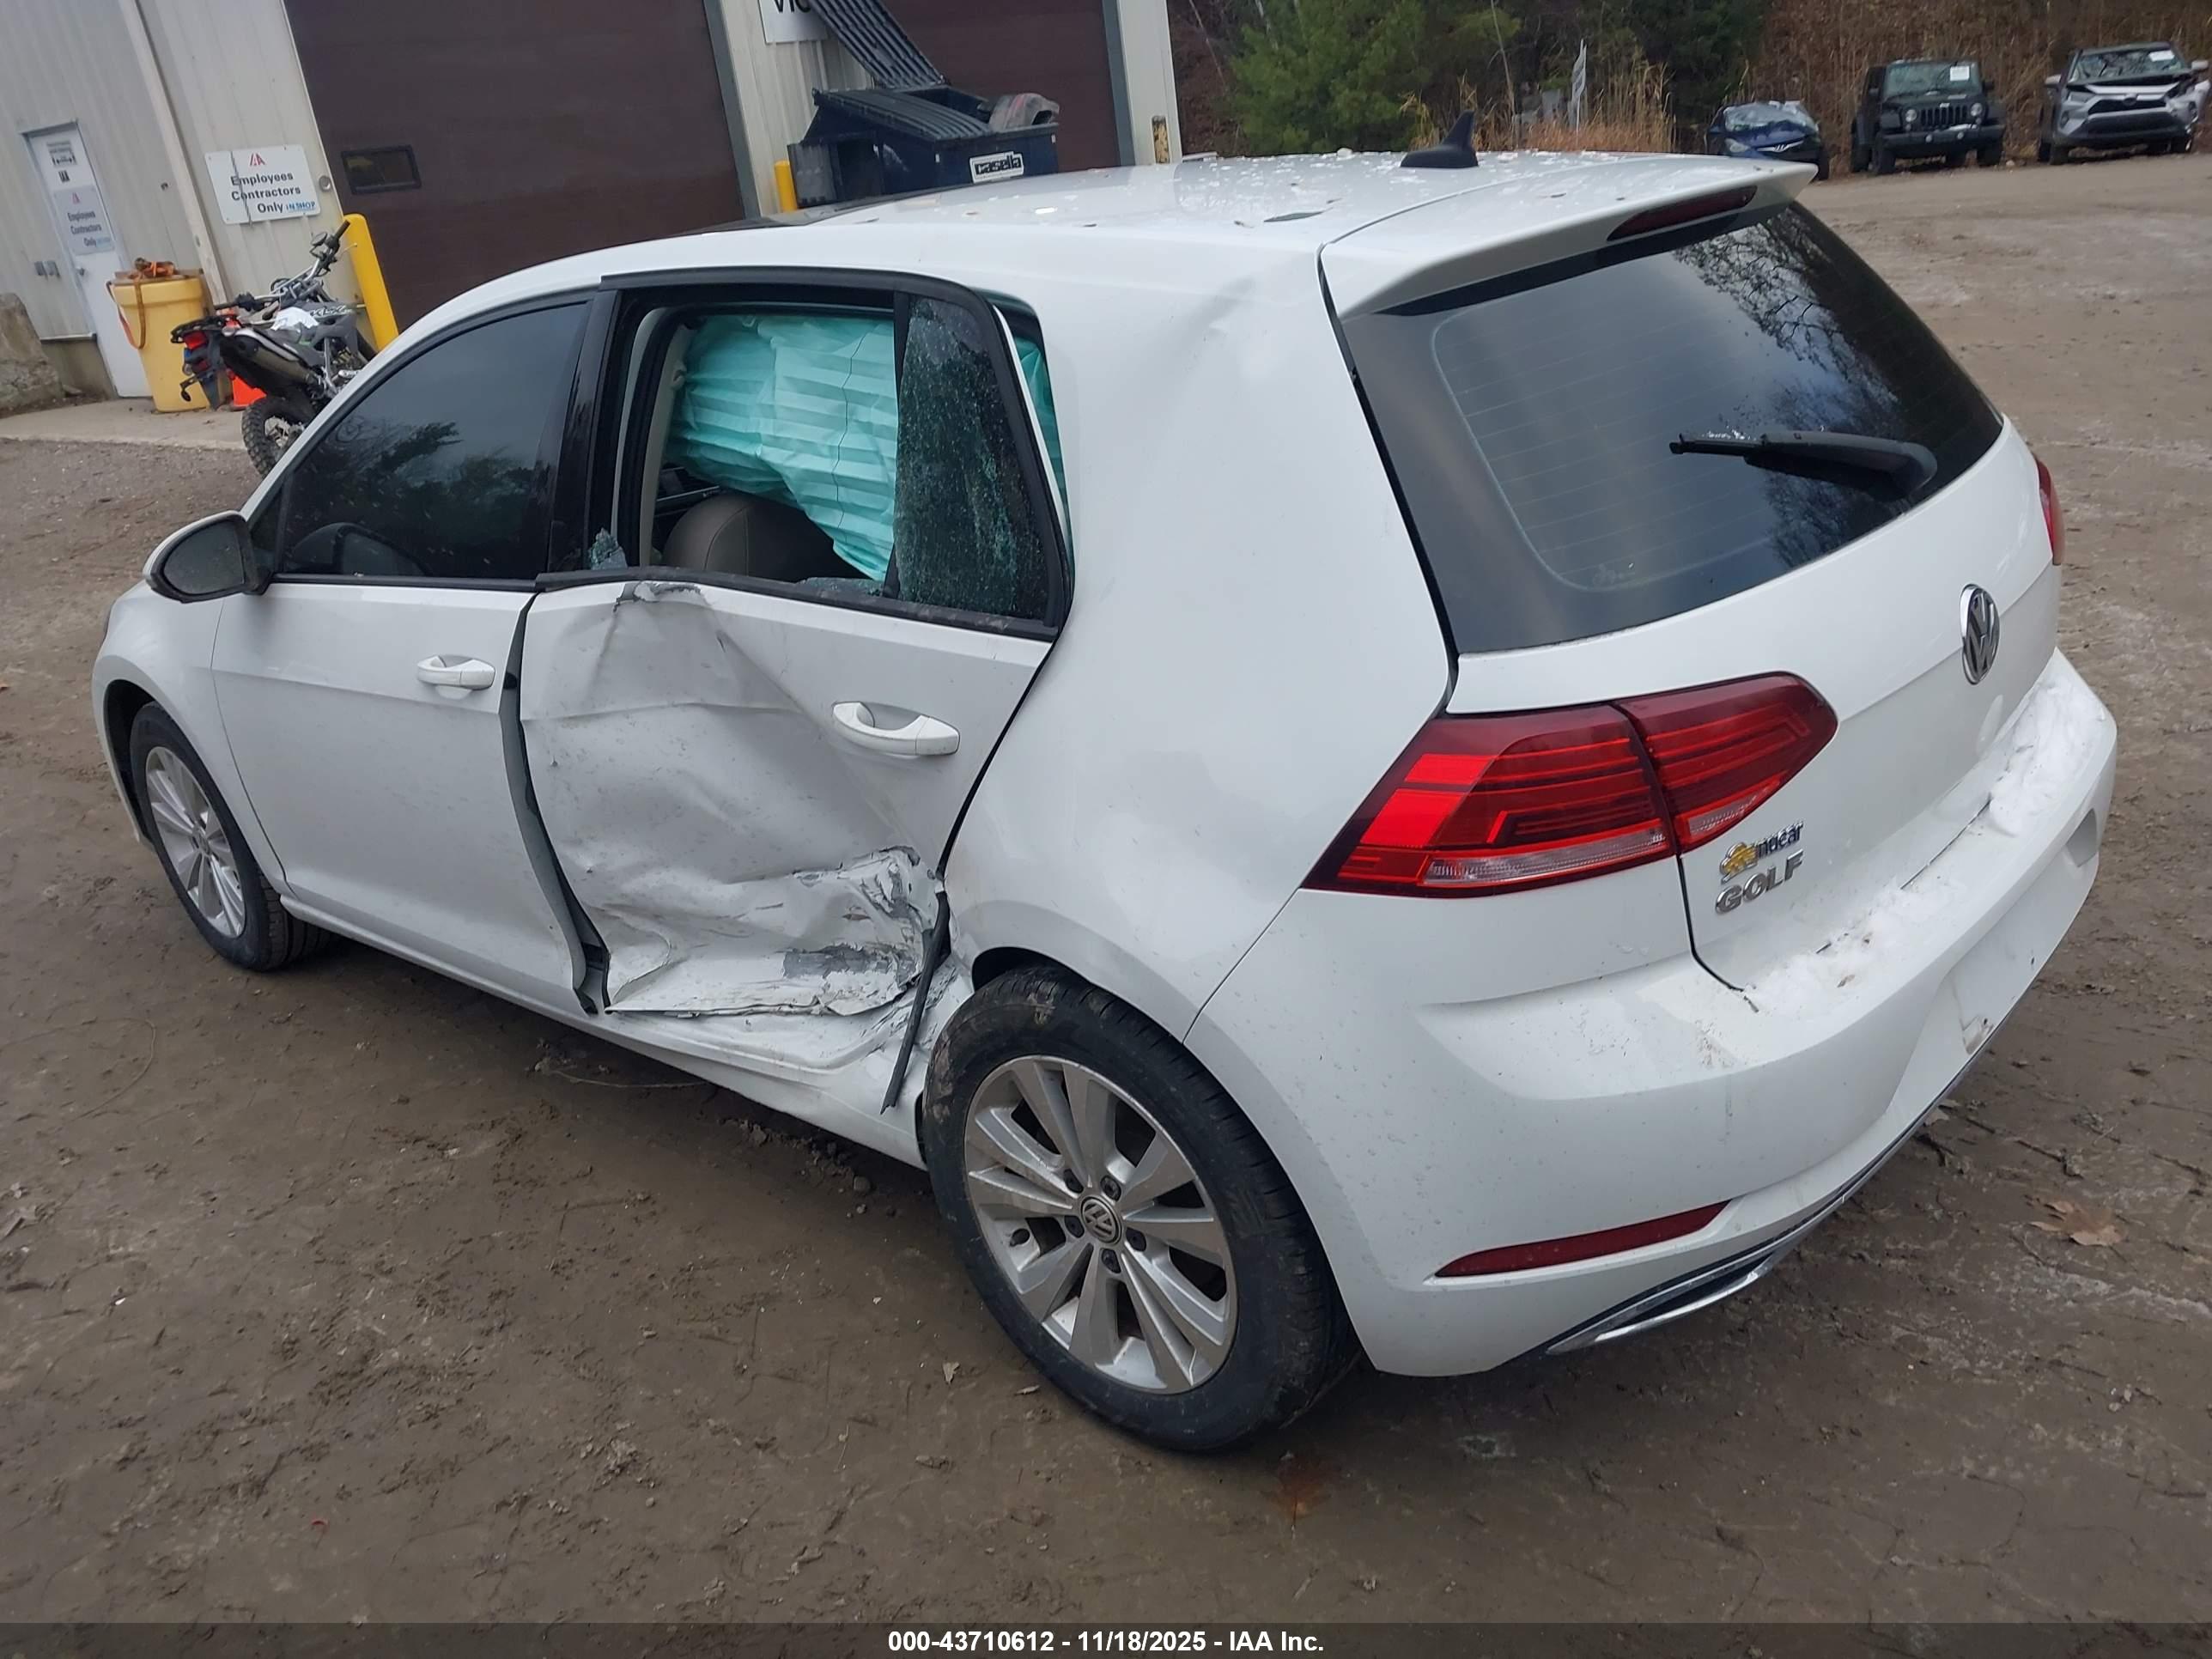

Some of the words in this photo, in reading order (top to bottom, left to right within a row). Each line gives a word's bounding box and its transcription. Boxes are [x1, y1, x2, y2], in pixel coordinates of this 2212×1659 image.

[975, 154, 1022, 175] casella
[230, 172, 294, 186] Employees
[231, 186, 301, 201] Contractors
[257, 202, 283, 213] Only
[1715, 848, 1804, 914] GOLF
